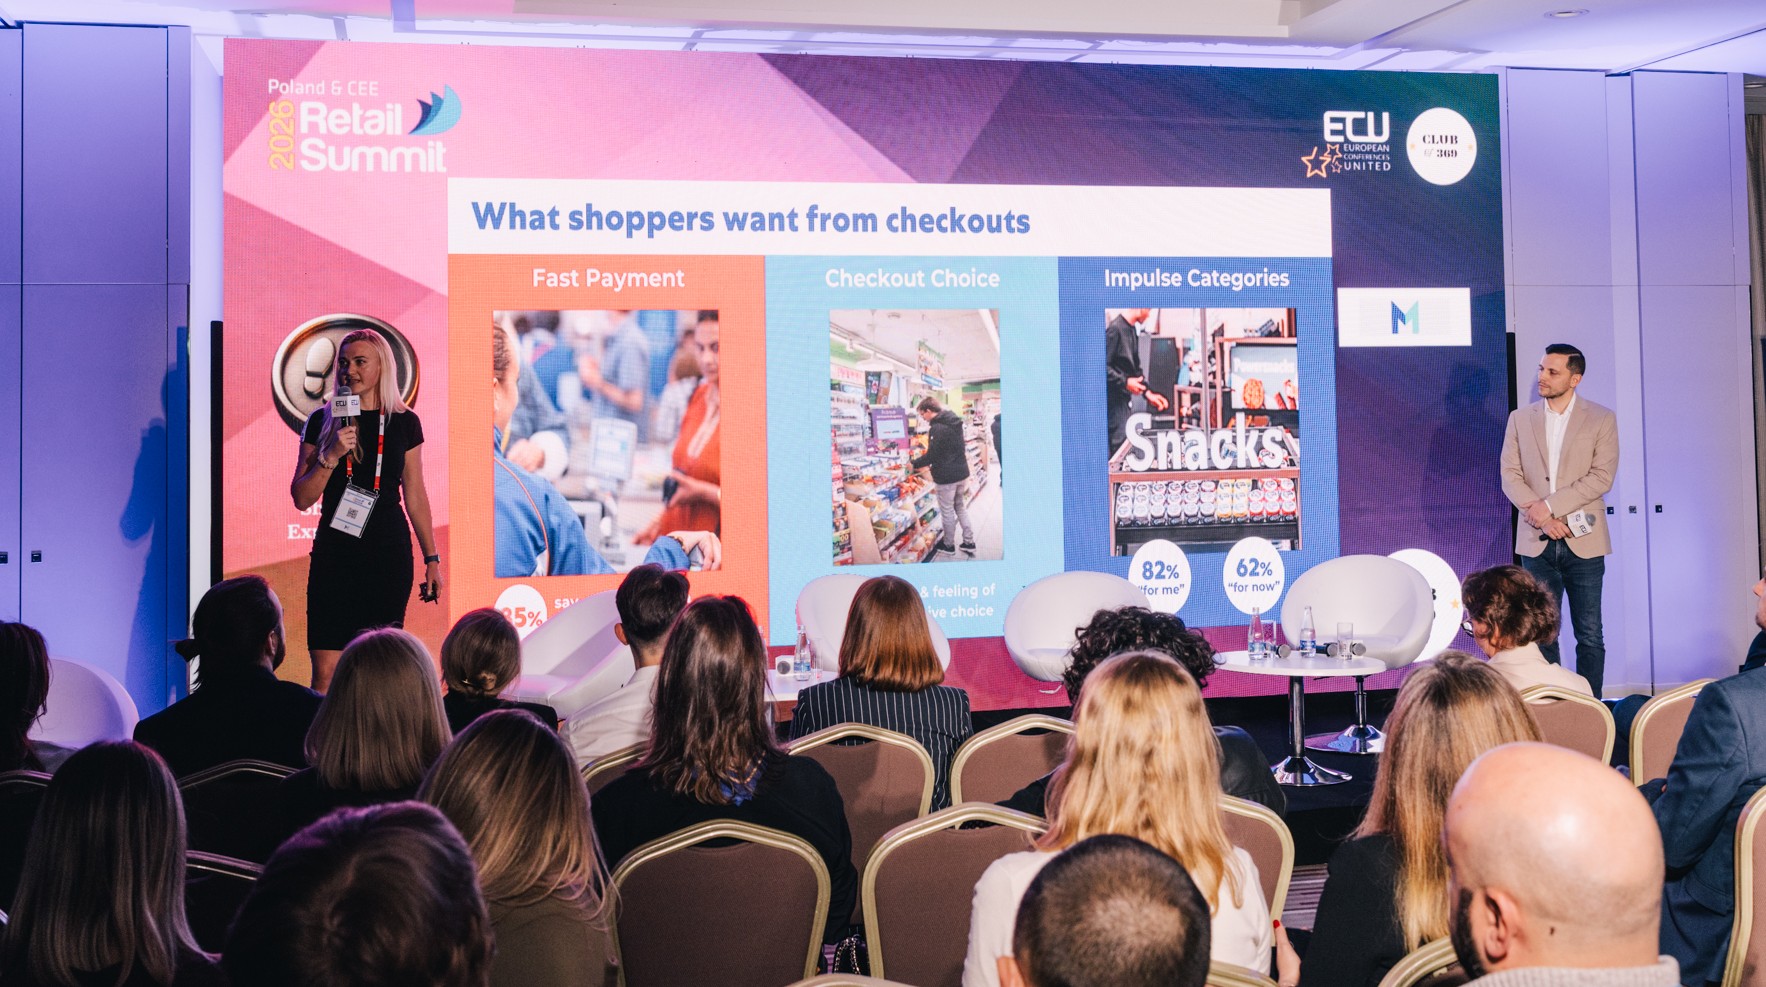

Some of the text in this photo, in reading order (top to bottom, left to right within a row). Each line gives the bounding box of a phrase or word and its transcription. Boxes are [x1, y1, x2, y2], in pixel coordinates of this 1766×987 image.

[268, 79, 379, 96] Poland & CEE
[300, 101, 403, 135] Retail
[1324, 110, 1390, 143] ECU
[269, 100, 295, 170] 2026
[1422, 134, 1458, 145] CLUB
[300, 137, 447, 173] Summit
[1343, 143, 1390, 152] EUROPEAN
[1343, 153, 1390, 161] CONFERENCES
[1436, 149, 1457, 158] 369
[1343, 161, 1391, 171] UNITED
[471, 201, 1031, 239] What shoppers want from checkouts
[532, 268, 685, 292] Fast Payment
[825, 267, 1000, 288] Checkout Choice
[1104, 267, 1290, 291] Impulse Categories
[1125, 412, 1283, 472] Snacks
[1142, 560, 1180, 580] 82%
[1236, 557, 1273, 577] 62%
[920, 583, 996, 599] & feeling of
[1228, 580, 1280, 593] “for now”
[950, 603, 994, 618] choice
